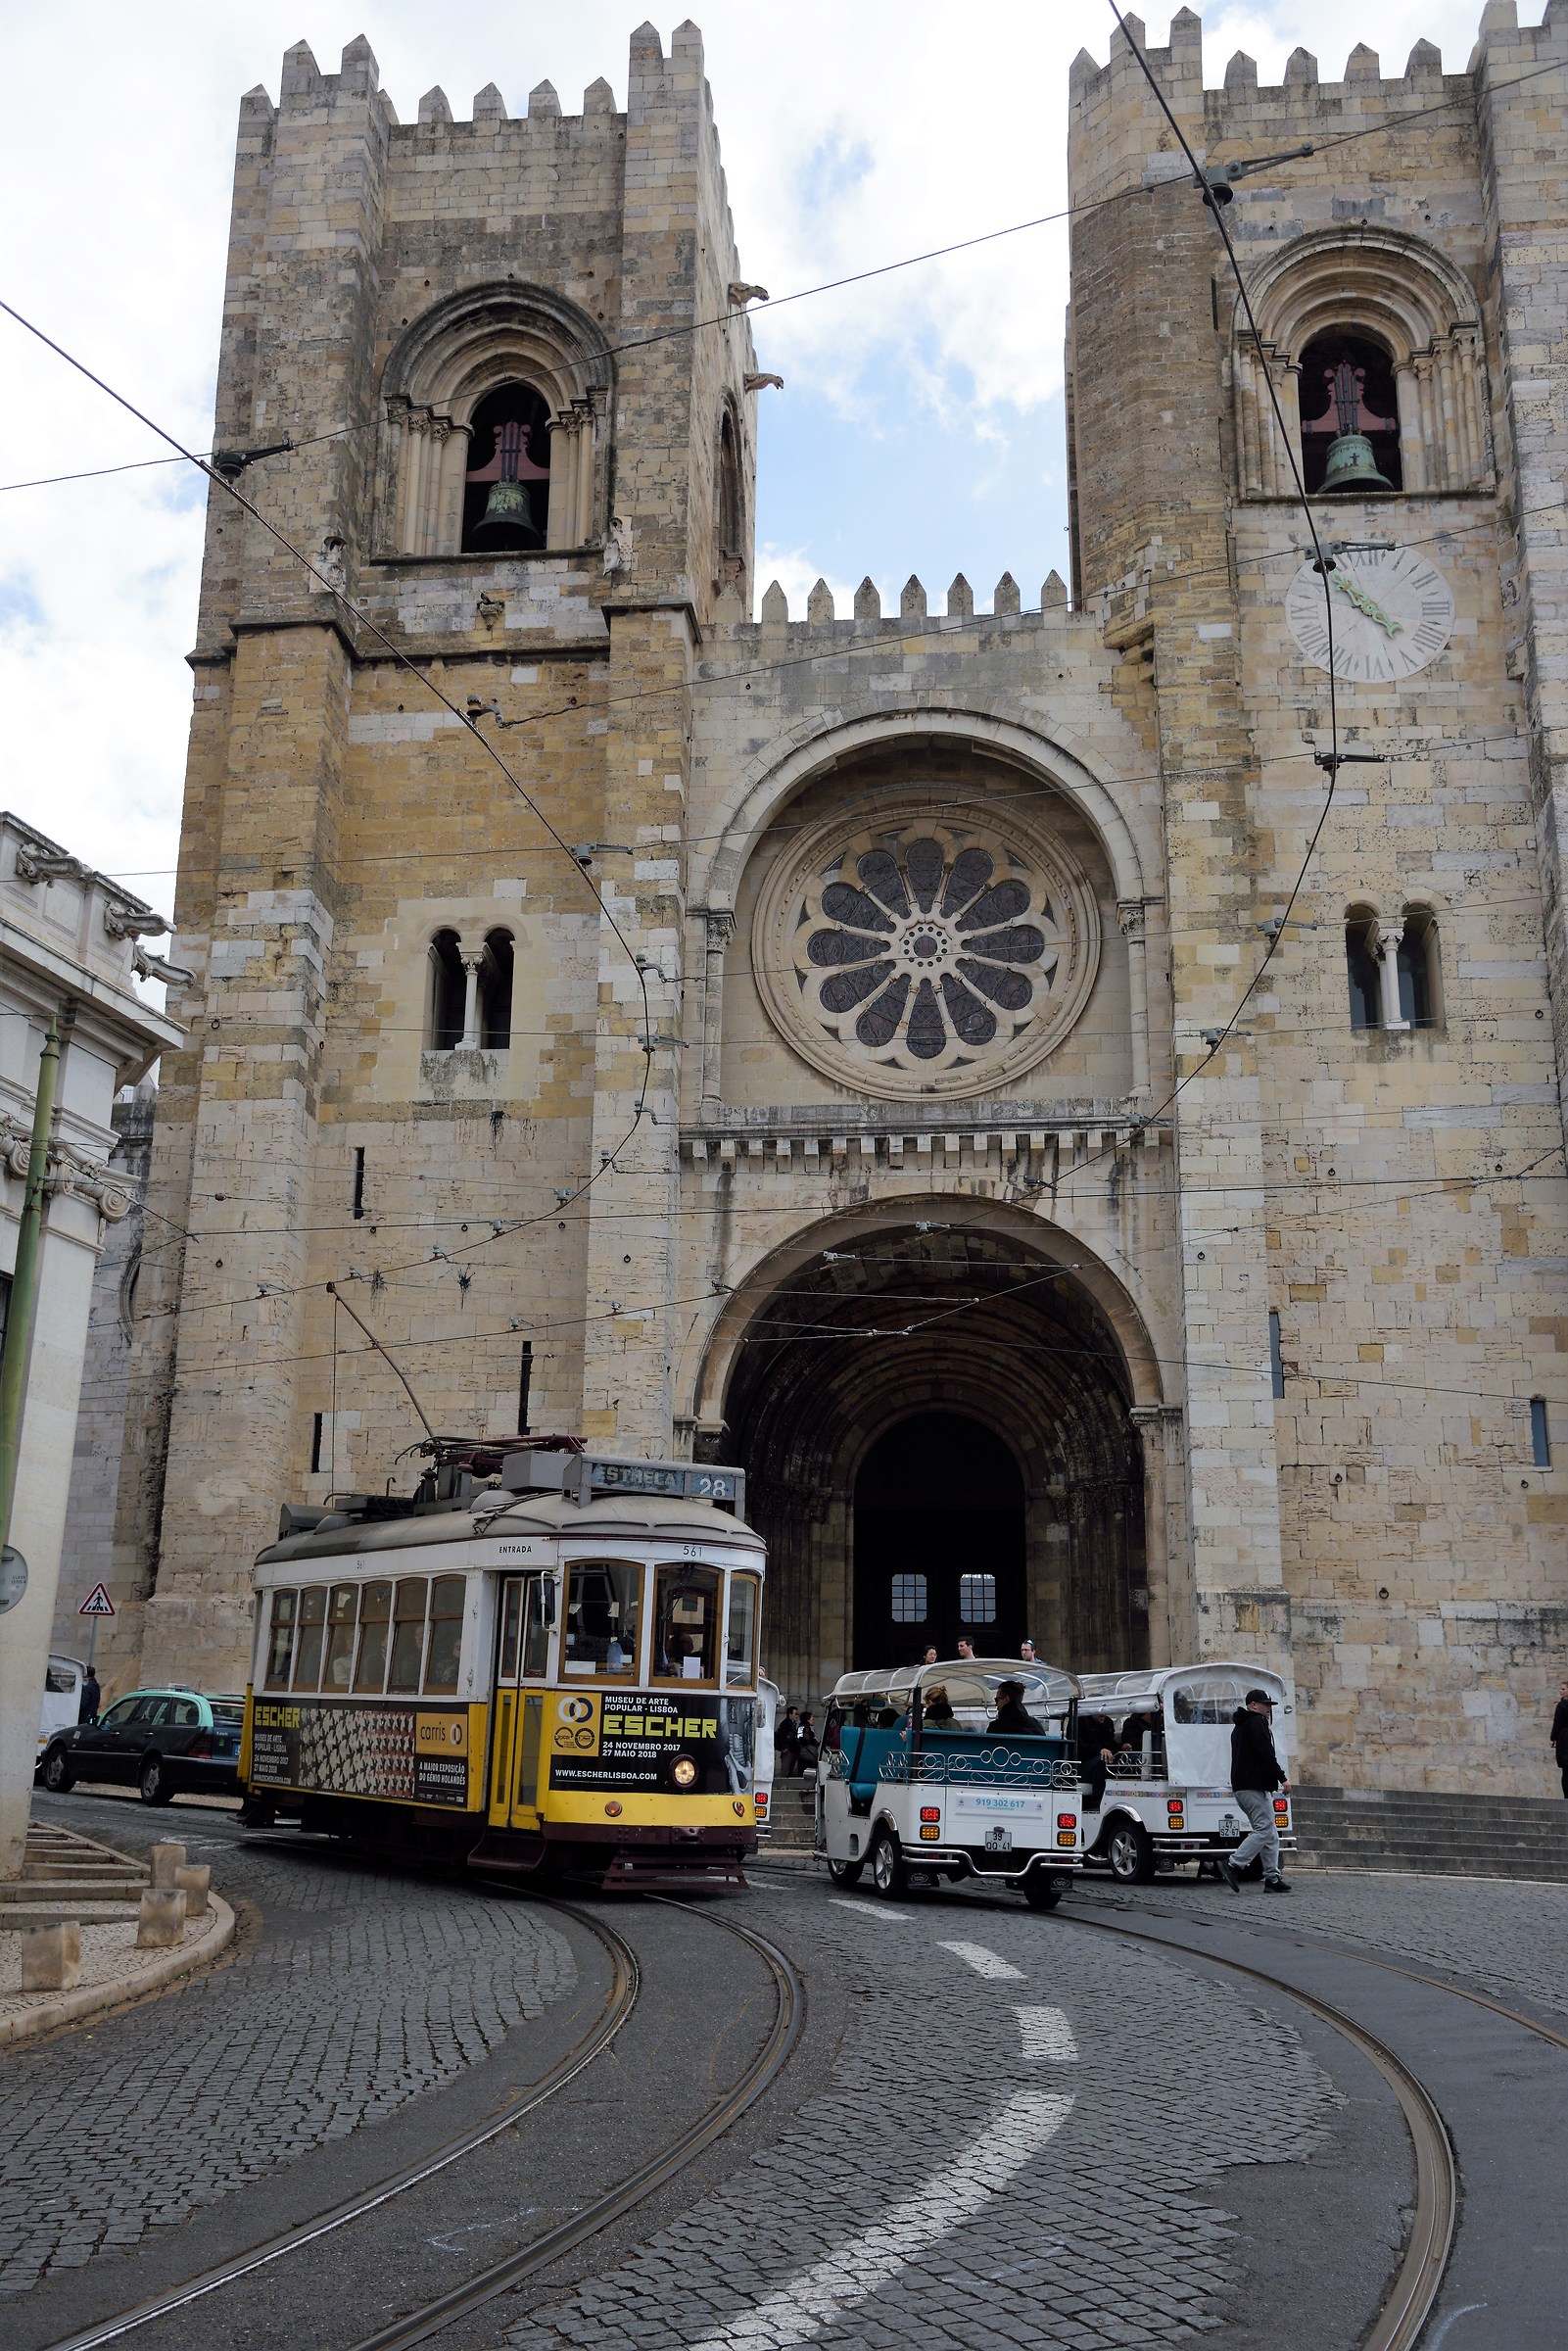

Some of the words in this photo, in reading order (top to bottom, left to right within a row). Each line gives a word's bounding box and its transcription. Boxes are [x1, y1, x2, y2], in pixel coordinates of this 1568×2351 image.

[1421, 600, 1451, 616] III
[699, 1477, 726, 1498] 28
[499, 1545, 532, 1554] ENTRADA
[683, 1545, 703, 1558] 561
[605, 1696, 634, 1704] MUSEU
[604, 1703, 642, 1712] POPULAR
[649, 1704, 678, 1714] LISBOA
[255, 1705, 301, 1728] ESCHER
[420, 1721, 446, 1742] carris
[602, 1714, 717, 1739] ESCHER
[615, 1742, 661, 1751] NOVEMBRO
[423, 1762, 439, 1772] MAIOR
[418, 1772, 426, 1781] DO
[554, 1769, 657, 1781] WWW.ESCHERLISBOA.COM
[975, 1798, 991, 1806] 919
[992, 1832, 1003, 1842] 39
